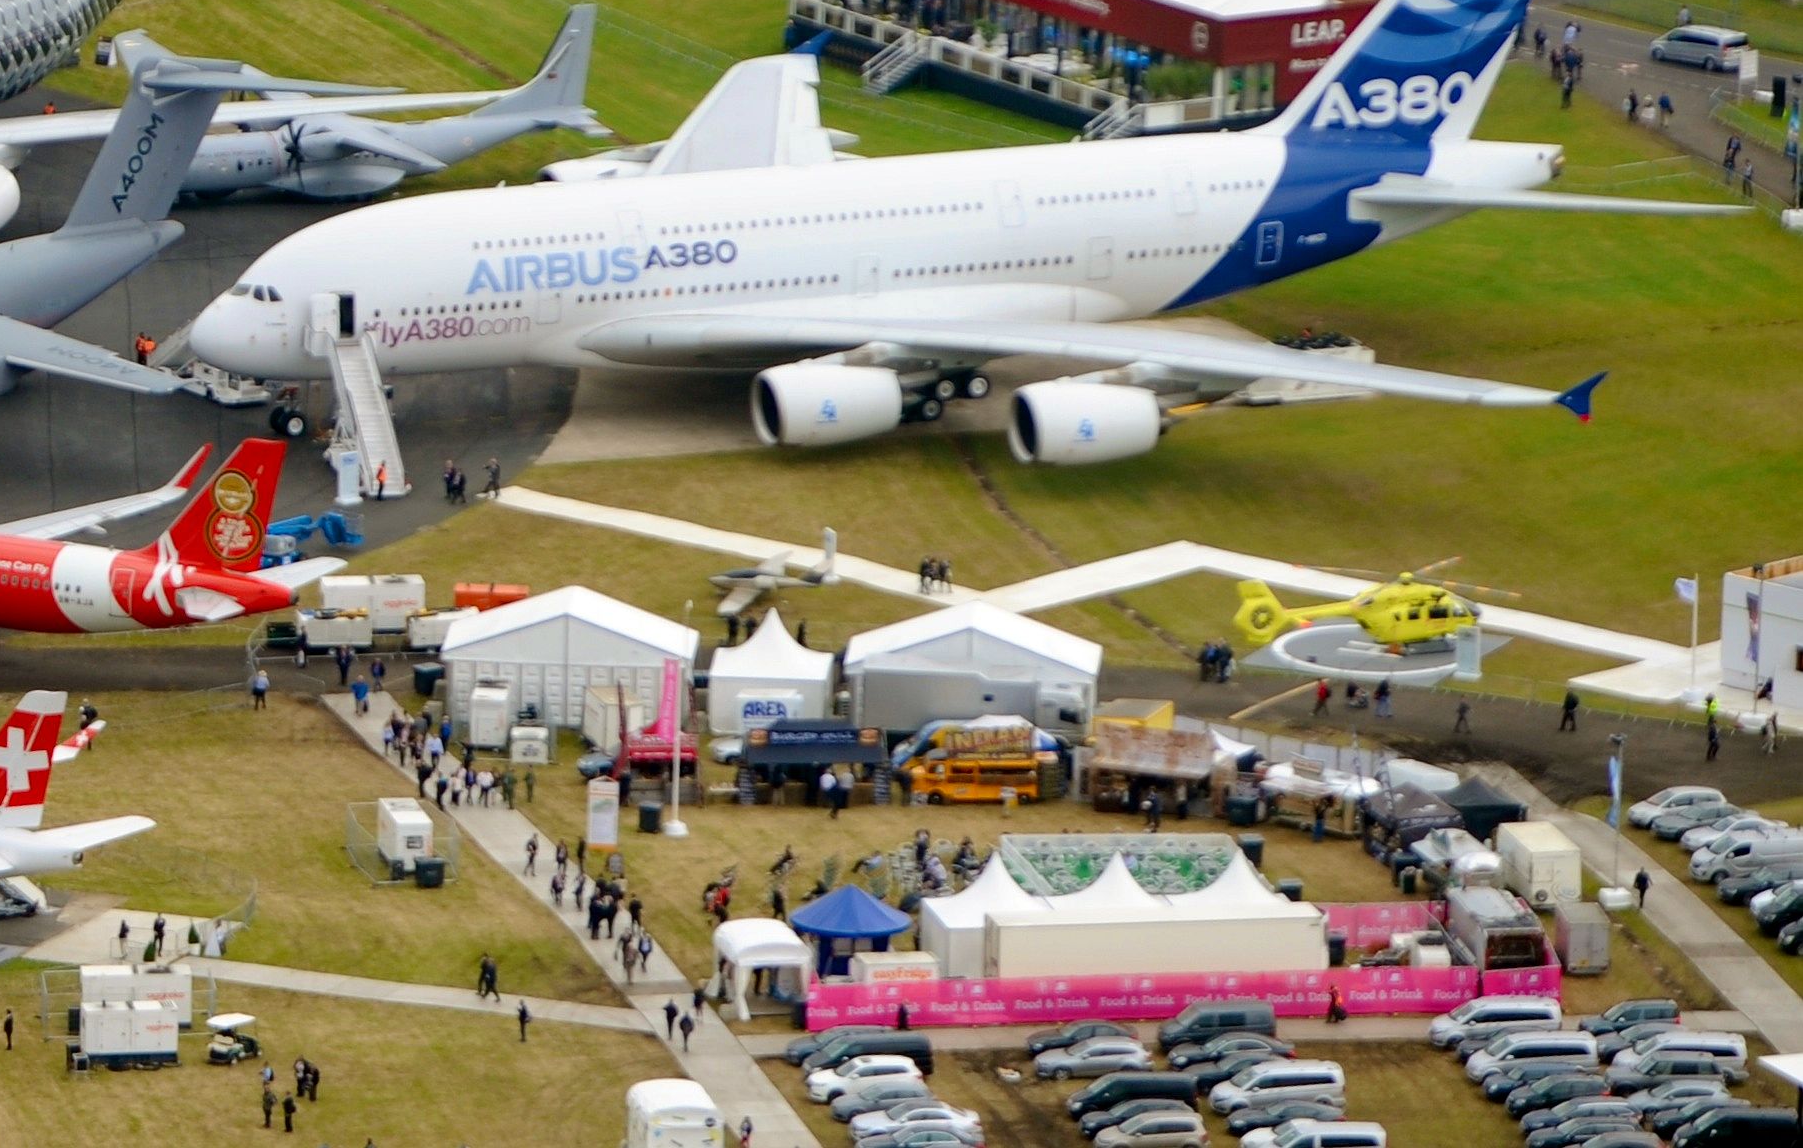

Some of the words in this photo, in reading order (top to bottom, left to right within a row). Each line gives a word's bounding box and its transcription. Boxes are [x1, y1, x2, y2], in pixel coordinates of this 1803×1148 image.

[1310, 70, 1475, 131] A380
[111, 112, 165, 213] A400M
[465, 246, 640, 295] AIRBUS
[644, 239, 738, 270] A380
[12, 559, 31, 572] Can
[31, 562, 49, 576] Fly
[744, 701, 787, 717] AREA
[1101, 996, 1127, 1006] Food
[1142, 995, 1174, 1005] Drink
[1266, 993, 1293, 1002] Food
[1349, 990, 1377, 1001] Food
[1391, 989, 1424, 1000] Drink
[847, 1004, 875, 1016] Food
[930, 1002, 960, 1013] Food
[973, 1001, 1006, 1012] Drink
[1014, 999, 1043, 1010] Food
[1057, 998, 1090, 1009] Drink
[808, 1006, 838, 1018] Drink
